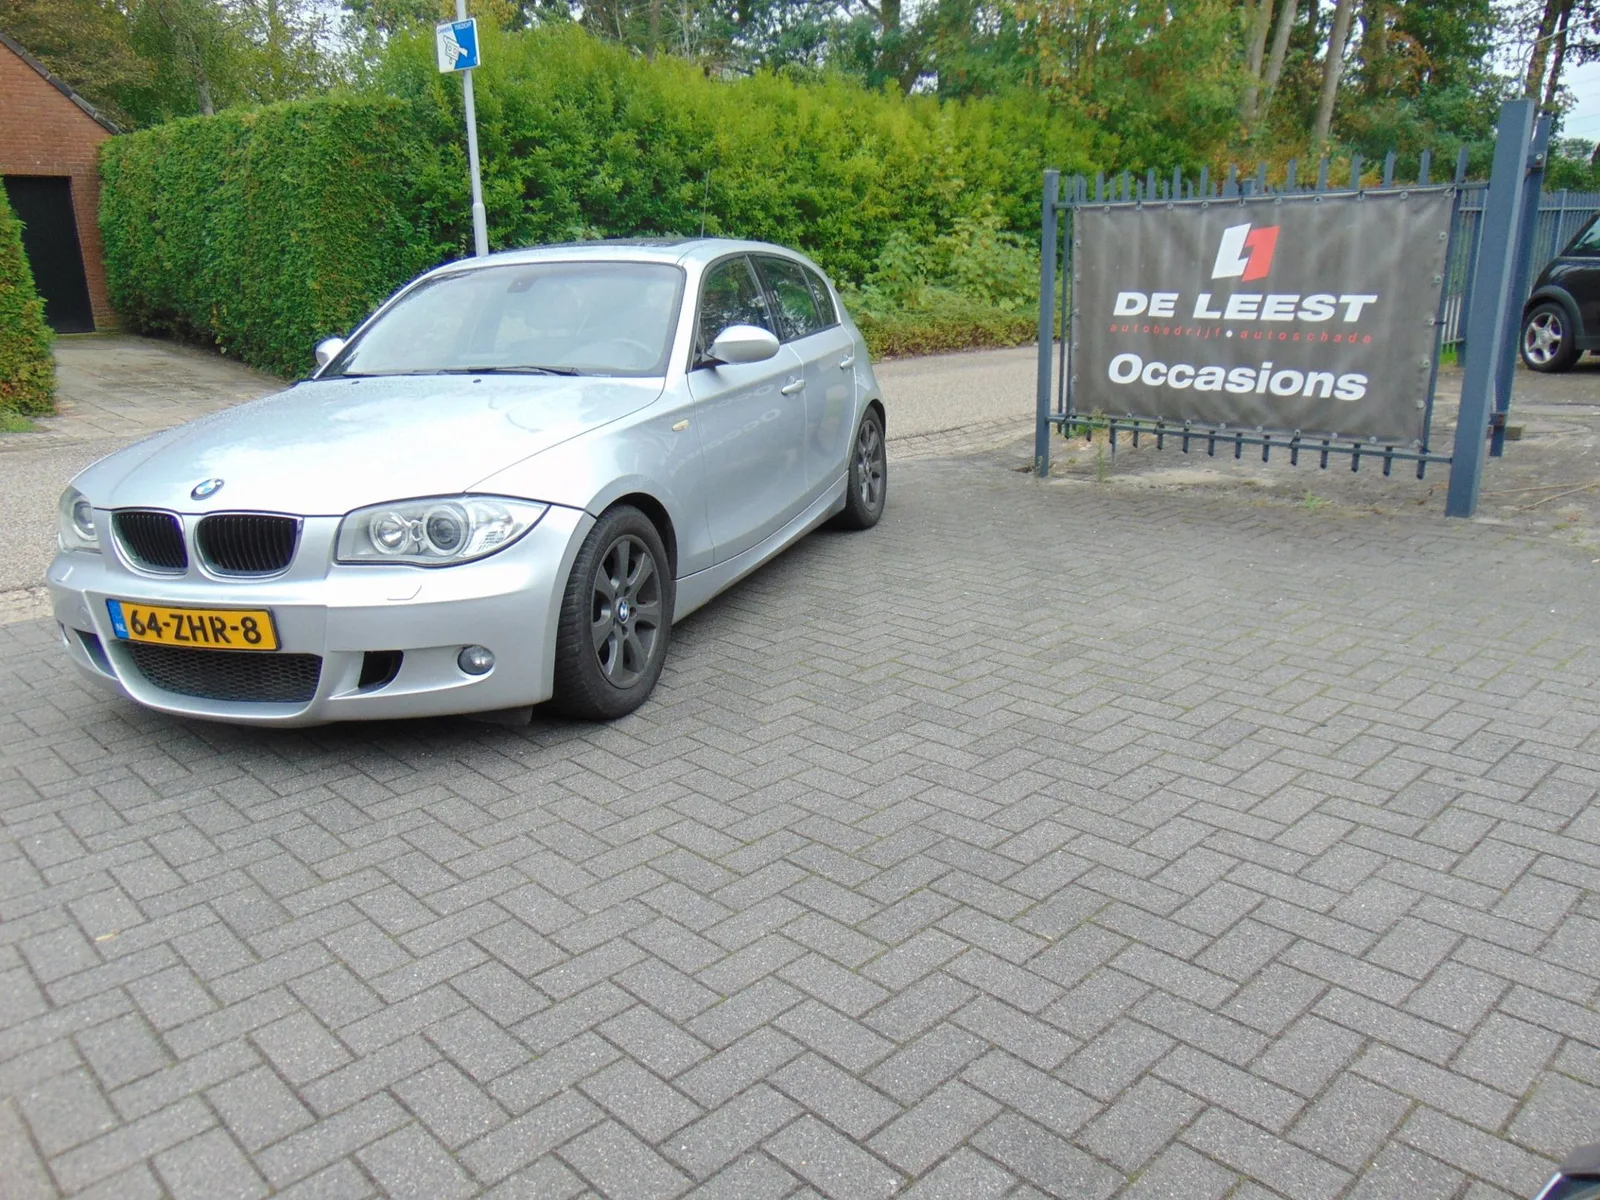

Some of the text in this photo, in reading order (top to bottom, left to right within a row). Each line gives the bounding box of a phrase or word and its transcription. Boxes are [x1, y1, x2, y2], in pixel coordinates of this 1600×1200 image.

[1113, 292, 1378, 322] DE LEEST
[1110, 323, 1373, 344] autobedrijf autoschade
[1108, 353, 1368, 401] Occasions
[130, 609, 262, 645] 64-ZHR-8
